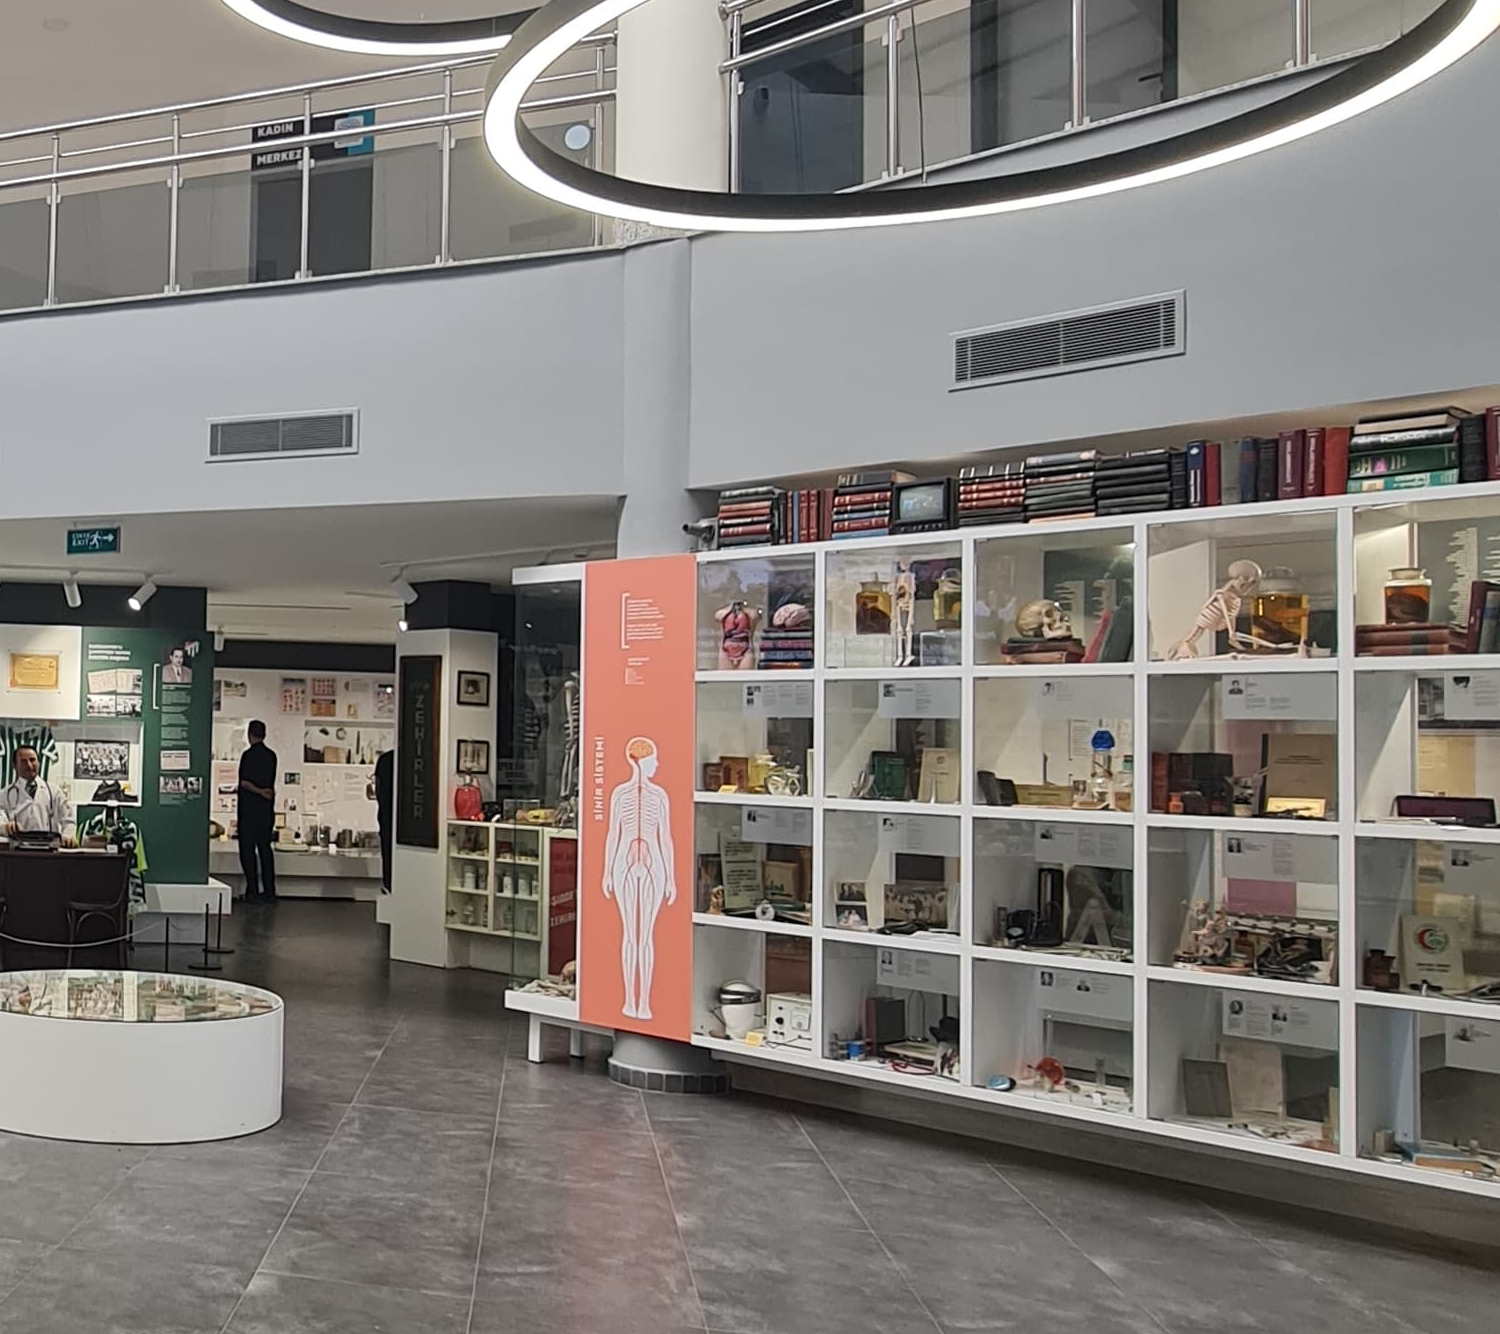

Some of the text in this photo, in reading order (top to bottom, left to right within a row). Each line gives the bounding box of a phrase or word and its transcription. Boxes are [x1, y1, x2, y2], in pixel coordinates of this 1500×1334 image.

[257, 122, 294, 138] KADIN
[593, 736, 605, 821] SİNİR SİSTEMİ
